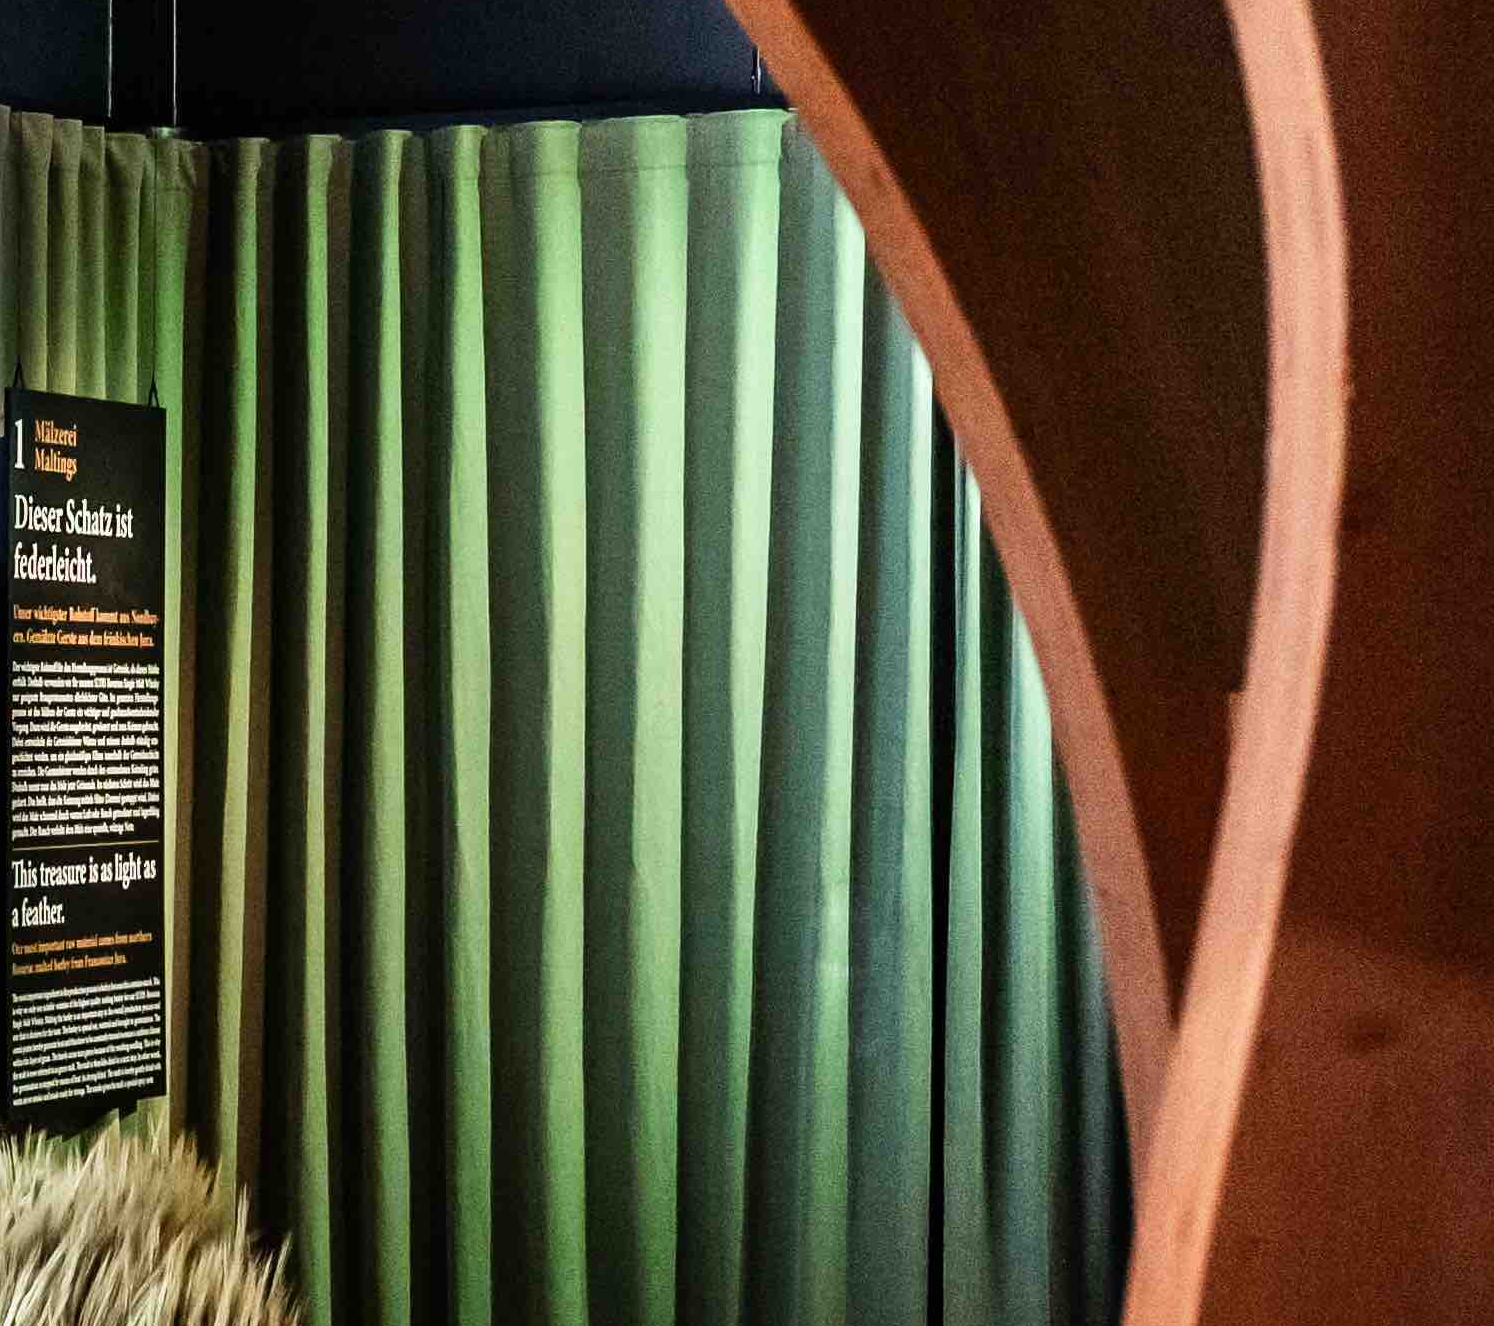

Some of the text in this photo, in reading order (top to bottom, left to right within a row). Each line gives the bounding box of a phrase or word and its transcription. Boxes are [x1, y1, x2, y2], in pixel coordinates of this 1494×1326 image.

[15, 419, 24, 469] 1
[35, 448, 77, 481] Maltings
[15, 494, 133, 539] Dieser Schatz ist
[14, 541, 96, 584] federleicht.
[12, 851, 156, 890] This treasure is as light as
[12, 896, 64, 928] a feather.
